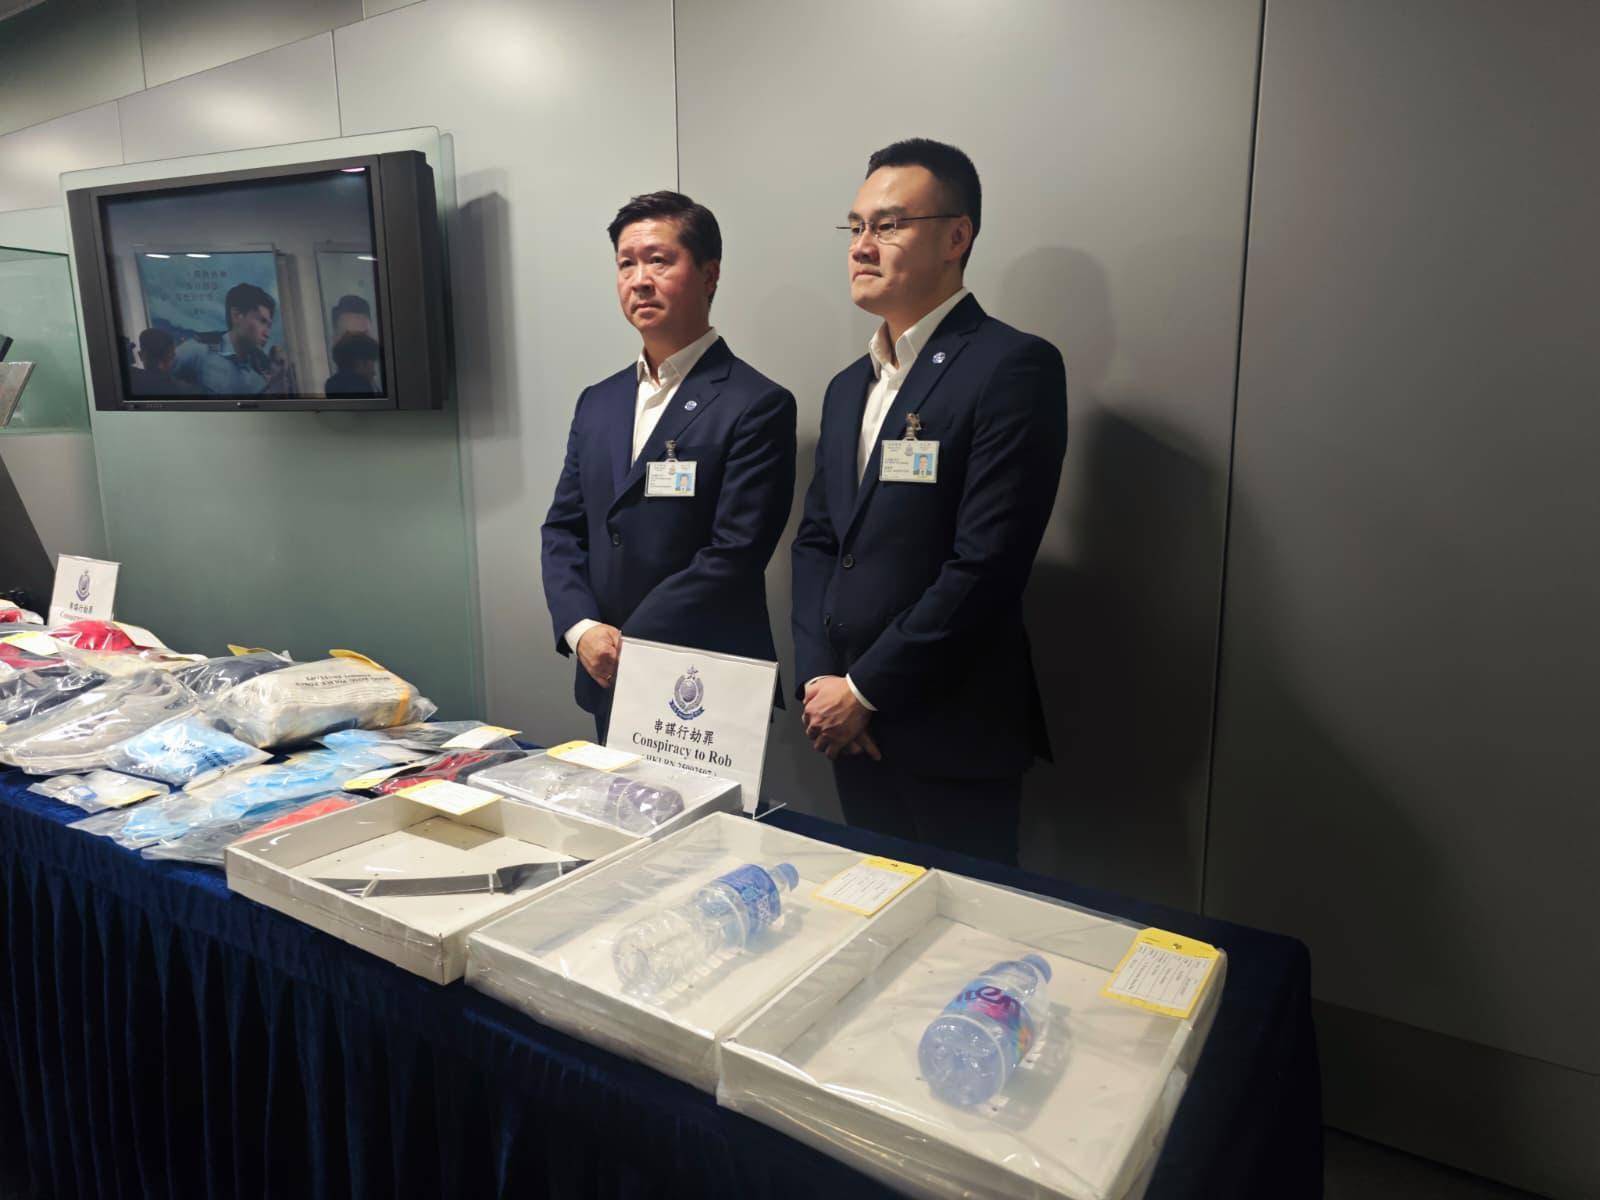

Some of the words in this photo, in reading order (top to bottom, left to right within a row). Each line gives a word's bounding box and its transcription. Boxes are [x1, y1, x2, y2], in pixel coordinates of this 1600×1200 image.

[654, 719, 714, 745] 串謀行劫罪
[632, 732, 691, 759] Conspiracy
[694, 749, 706, 760] to
[709, 750, 732, 767] Rob
